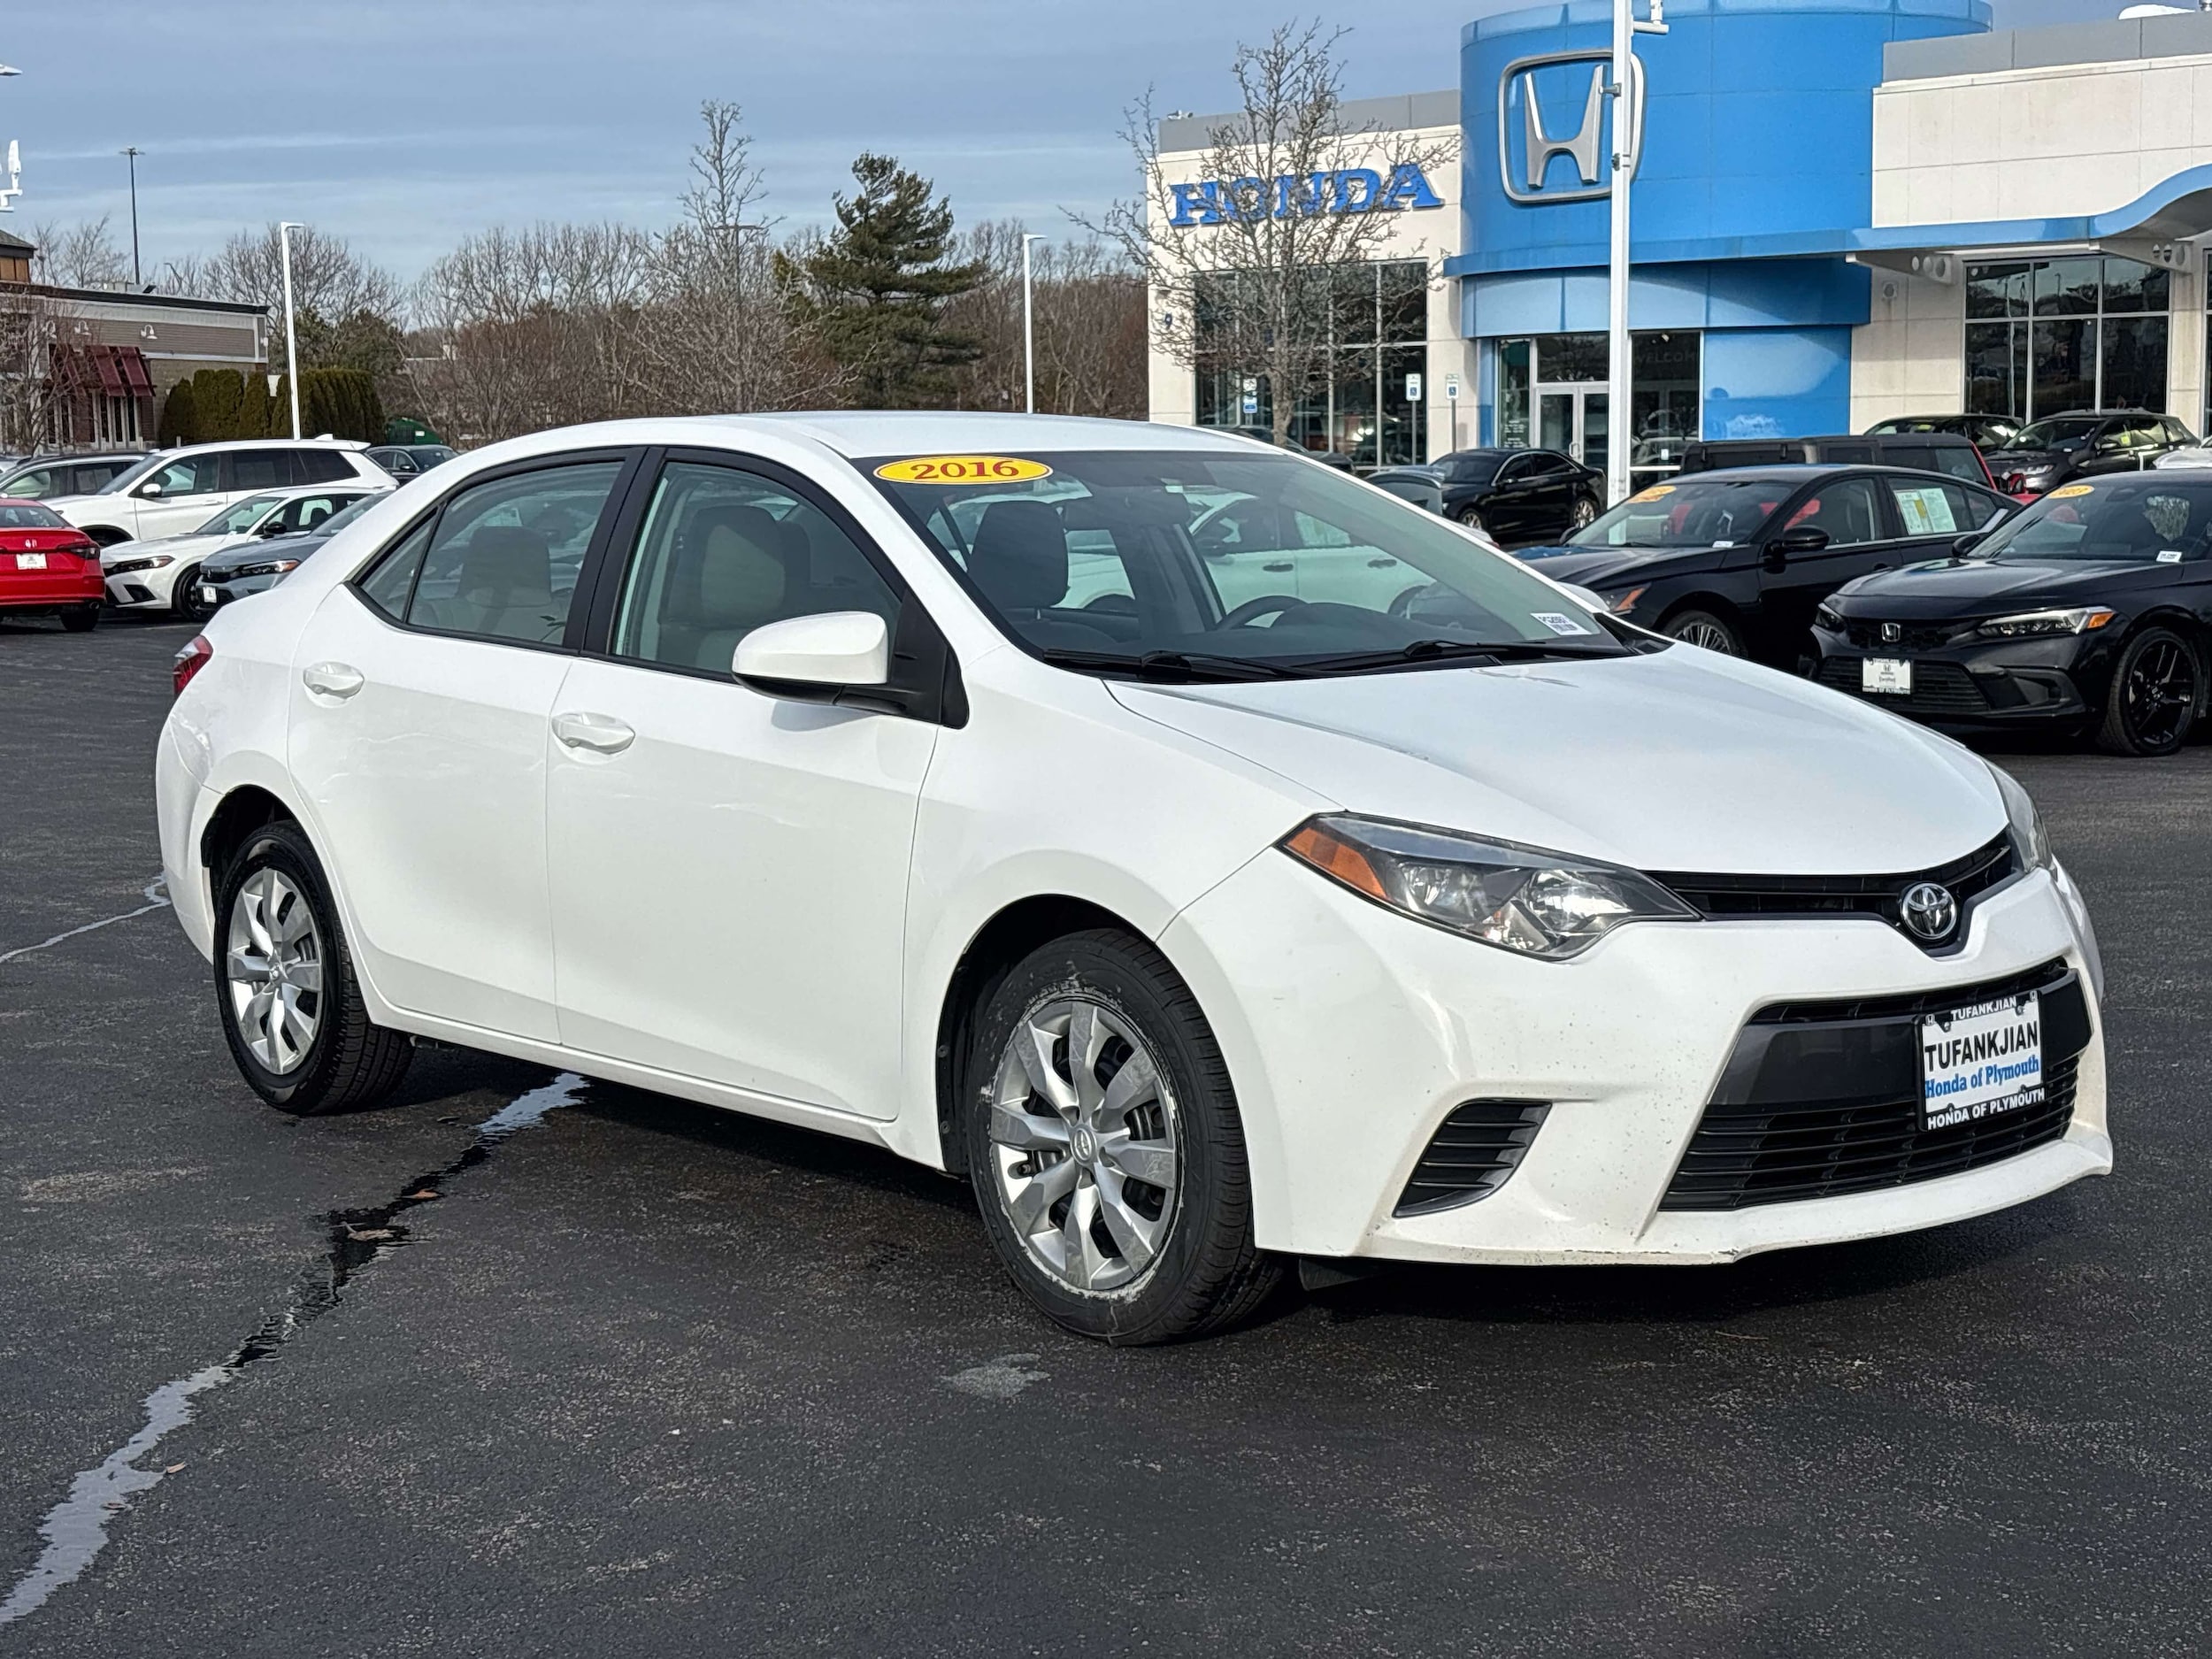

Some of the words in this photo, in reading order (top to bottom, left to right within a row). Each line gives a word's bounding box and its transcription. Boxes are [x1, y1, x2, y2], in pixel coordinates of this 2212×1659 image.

[1169, 164, 1444, 227] HONDA
[910, 460, 1019, 480] 2016
[1951, 996, 2017, 1021] TUFANKJIAN
[1924, 1020, 2039, 1072] TUFANKJIAN
[1924, 1073, 1968, 1099] Honda
[1970, 1067, 1983, 1089] of
[1985, 1055, 2039, 1087] Plymouth
[1927, 1109, 1970, 1131] HONDA
[1972, 1103, 1987, 1119] OF
[1990, 1088, 2046, 1115] PLYMOUTH
